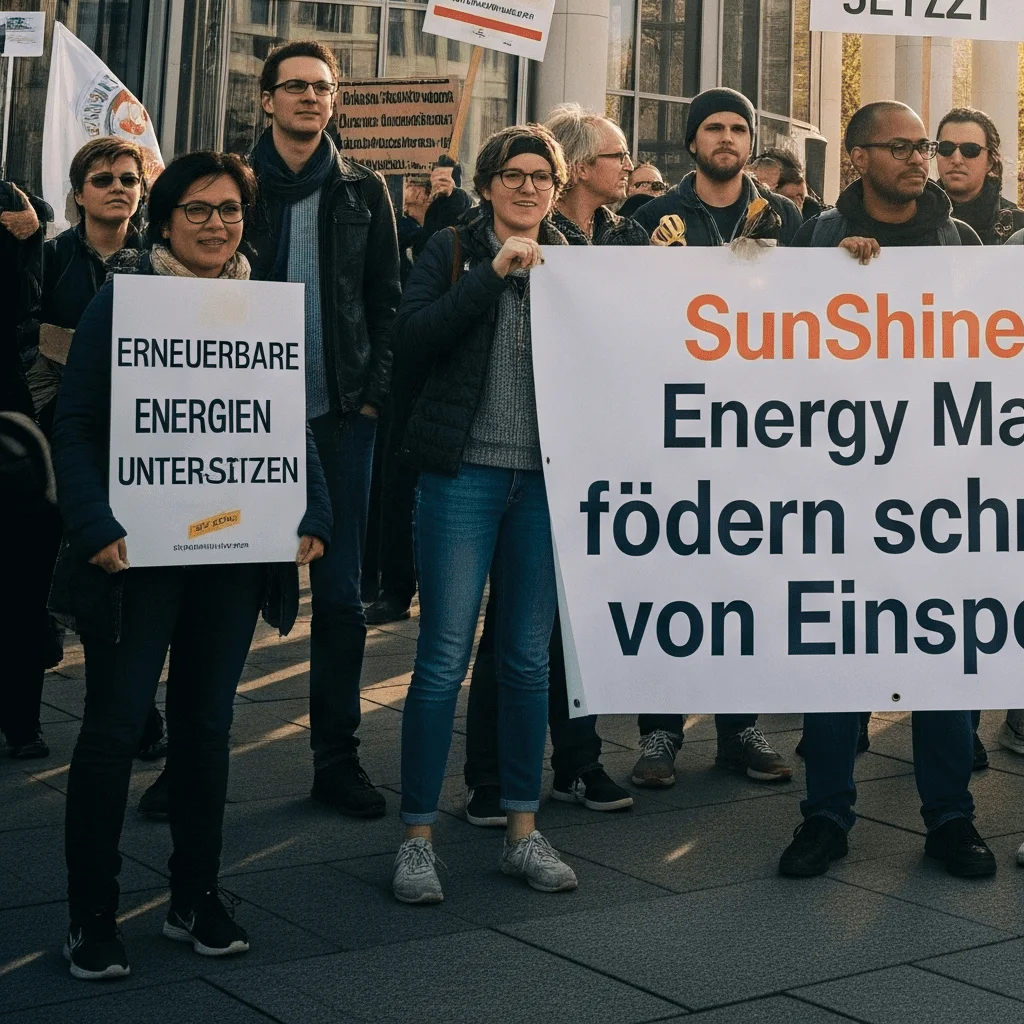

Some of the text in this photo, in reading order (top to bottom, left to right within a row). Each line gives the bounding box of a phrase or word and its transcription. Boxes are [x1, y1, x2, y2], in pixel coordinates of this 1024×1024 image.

[117, 337, 300, 371] ERNEUERBARE
[135, 398, 272, 434] ENERGIEN
[663, 382, 909, 467] Energy
[579, 479, 846, 557] födern
[607, 599, 756, 658] von
